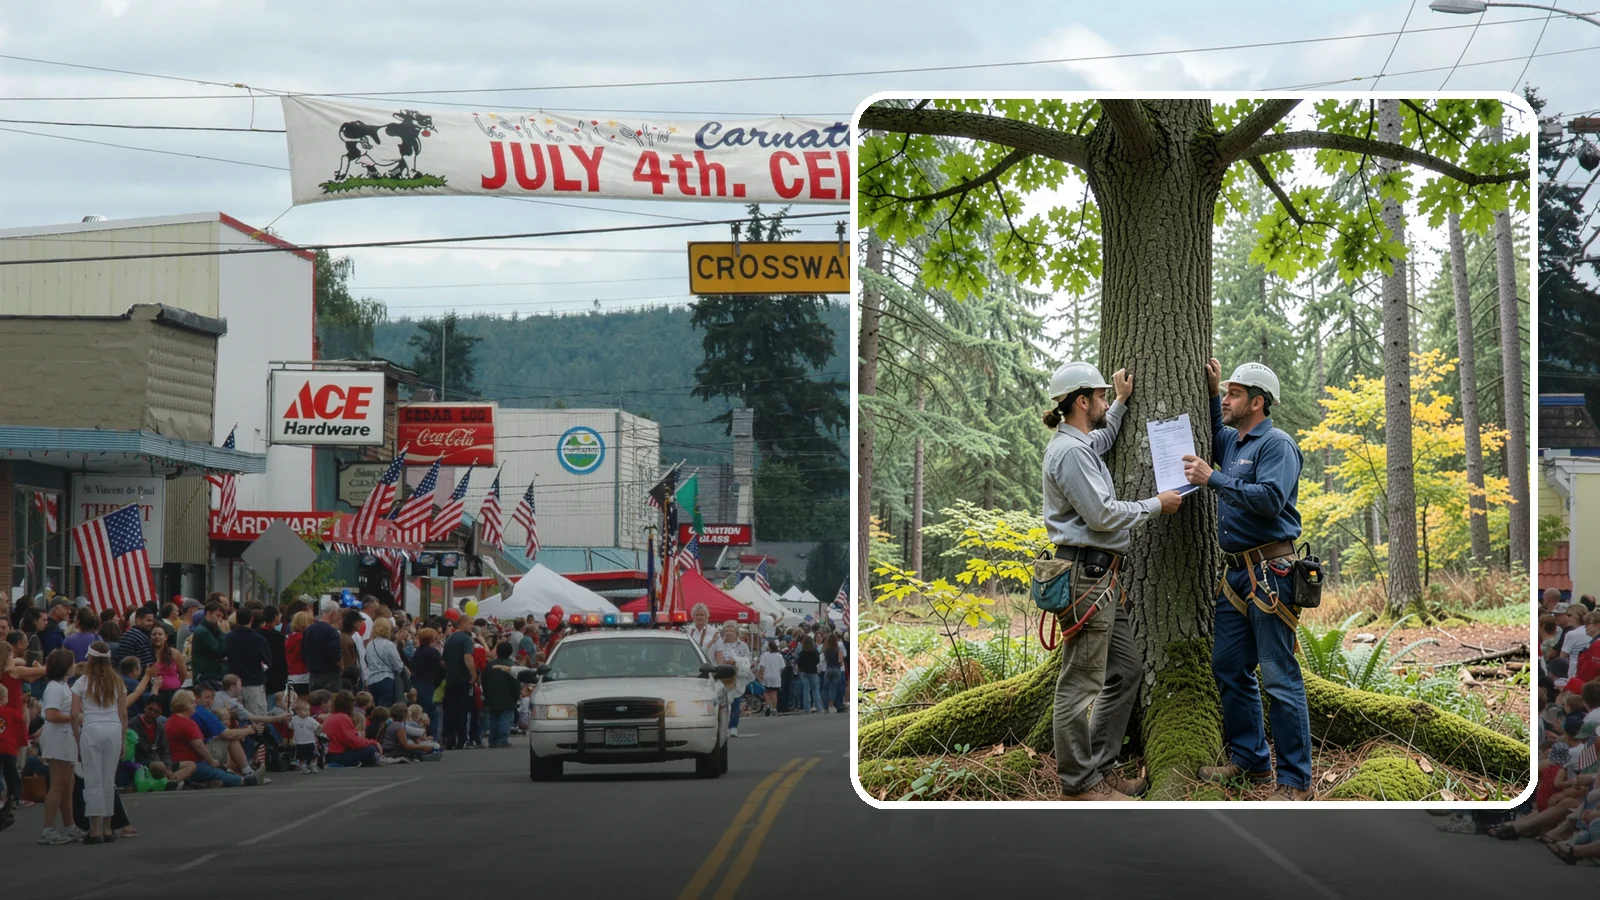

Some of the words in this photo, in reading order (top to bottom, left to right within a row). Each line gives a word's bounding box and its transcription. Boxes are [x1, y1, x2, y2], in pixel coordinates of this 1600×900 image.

[481, 141, 604, 193] JULY
[632, 150, 746, 197] 4th.
[697, 254, 850, 280] CROSSWA
[283, 380, 373, 420] ACE
[405, 409, 453, 422] CEDAR
[283, 421, 370, 437] Hardware
[83, 485, 94, 494] St.
[96, 486, 124, 495] Vincent
[126, 487, 136, 495] de
[138, 486, 155, 495] Paul
[213, 516, 331, 535] HARDARE
[688, 526, 741, 535] CRNATION
[699, 535, 730, 543] GLASS
